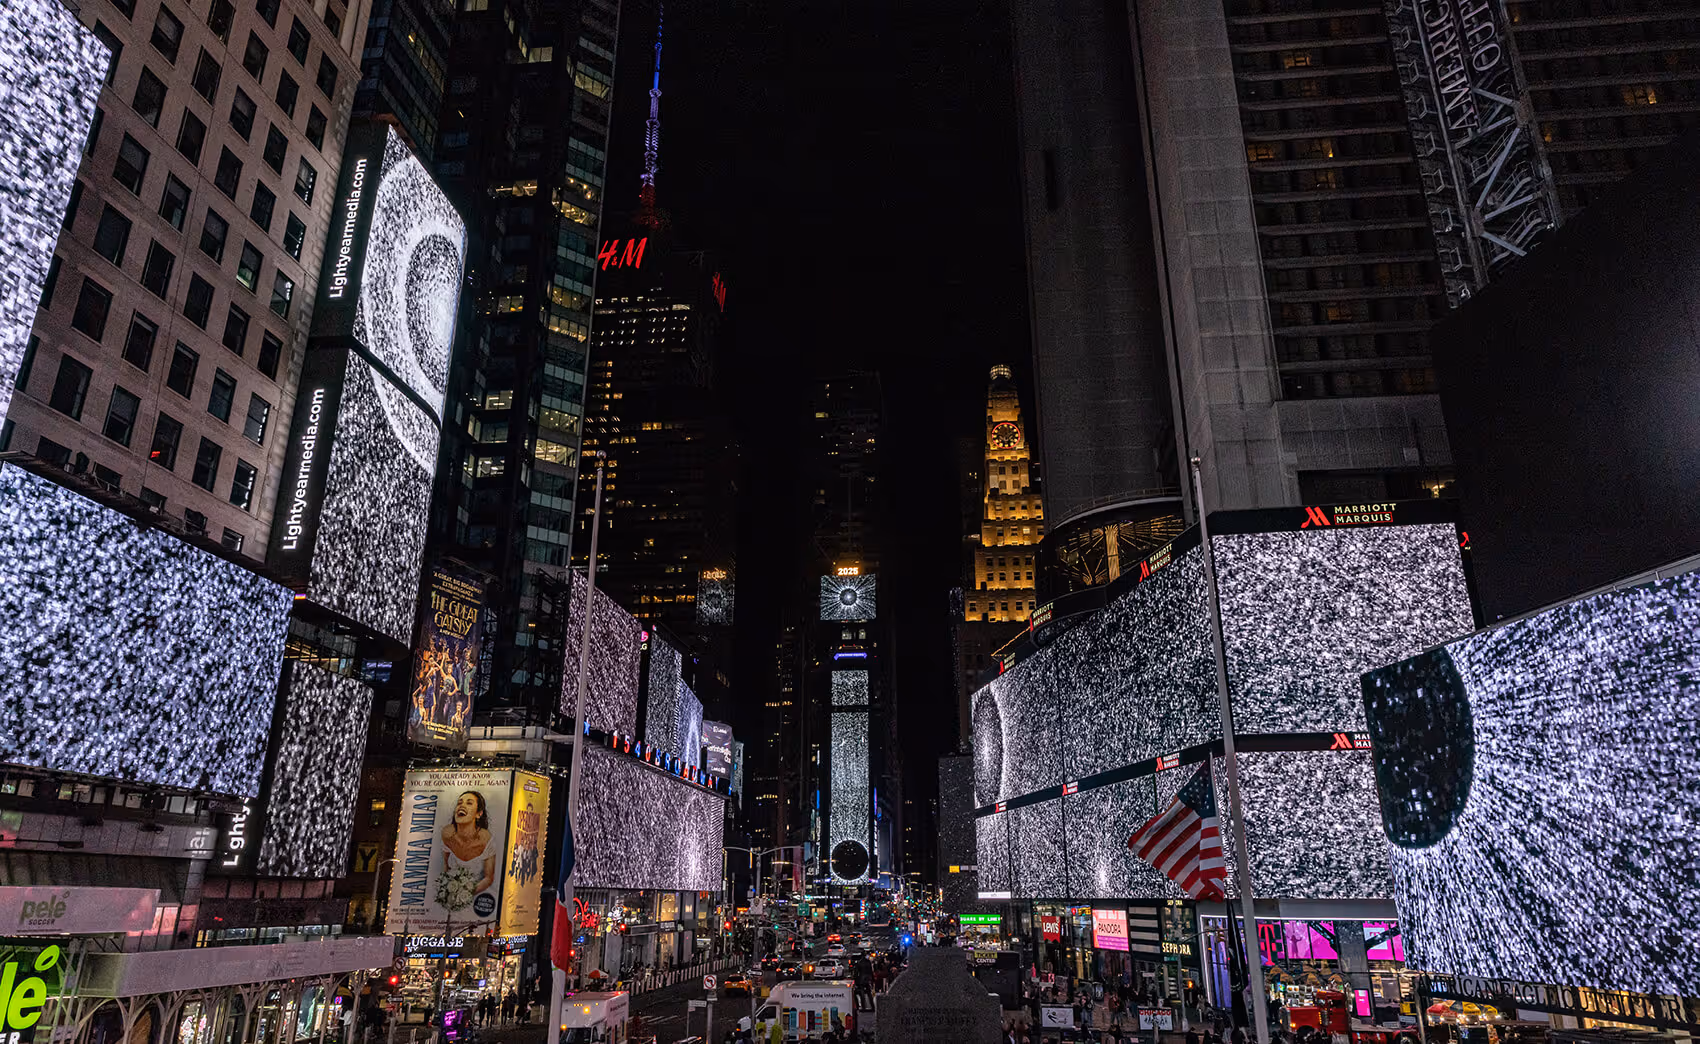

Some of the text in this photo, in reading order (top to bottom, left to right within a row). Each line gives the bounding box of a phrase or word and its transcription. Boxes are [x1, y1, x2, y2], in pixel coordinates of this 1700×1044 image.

[1457, 0, 1502, 72] OUT
[1420, 0, 1479, 130] AMERIC
[328, 158, 368, 299] Lightyearmedia.com
[597, 237, 648, 271] H&M
[282, 388, 325, 550] Lightyearmedia.com
[1334, 503, 1397, 514] MARRIOTT
[1335, 513, 1392, 524] MARQUIS
[837, 567, 859, 576] 2025
[431, 590, 449, 612] THE
[448, 600, 479, 624] GREAT
[434, 611, 473, 636] GATSBY
[409, 794, 438, 833] MIA!
[222, 797, 251, 867] Lghty
[399, 838, 433, 907] MAMMA
[28, 918, 56, 926] SOCCER
[1043, 922, 1059, 934] Levi's
[1098, 923, 1122, 935] PANDORA
[0, 944, 60, 1033] lé
